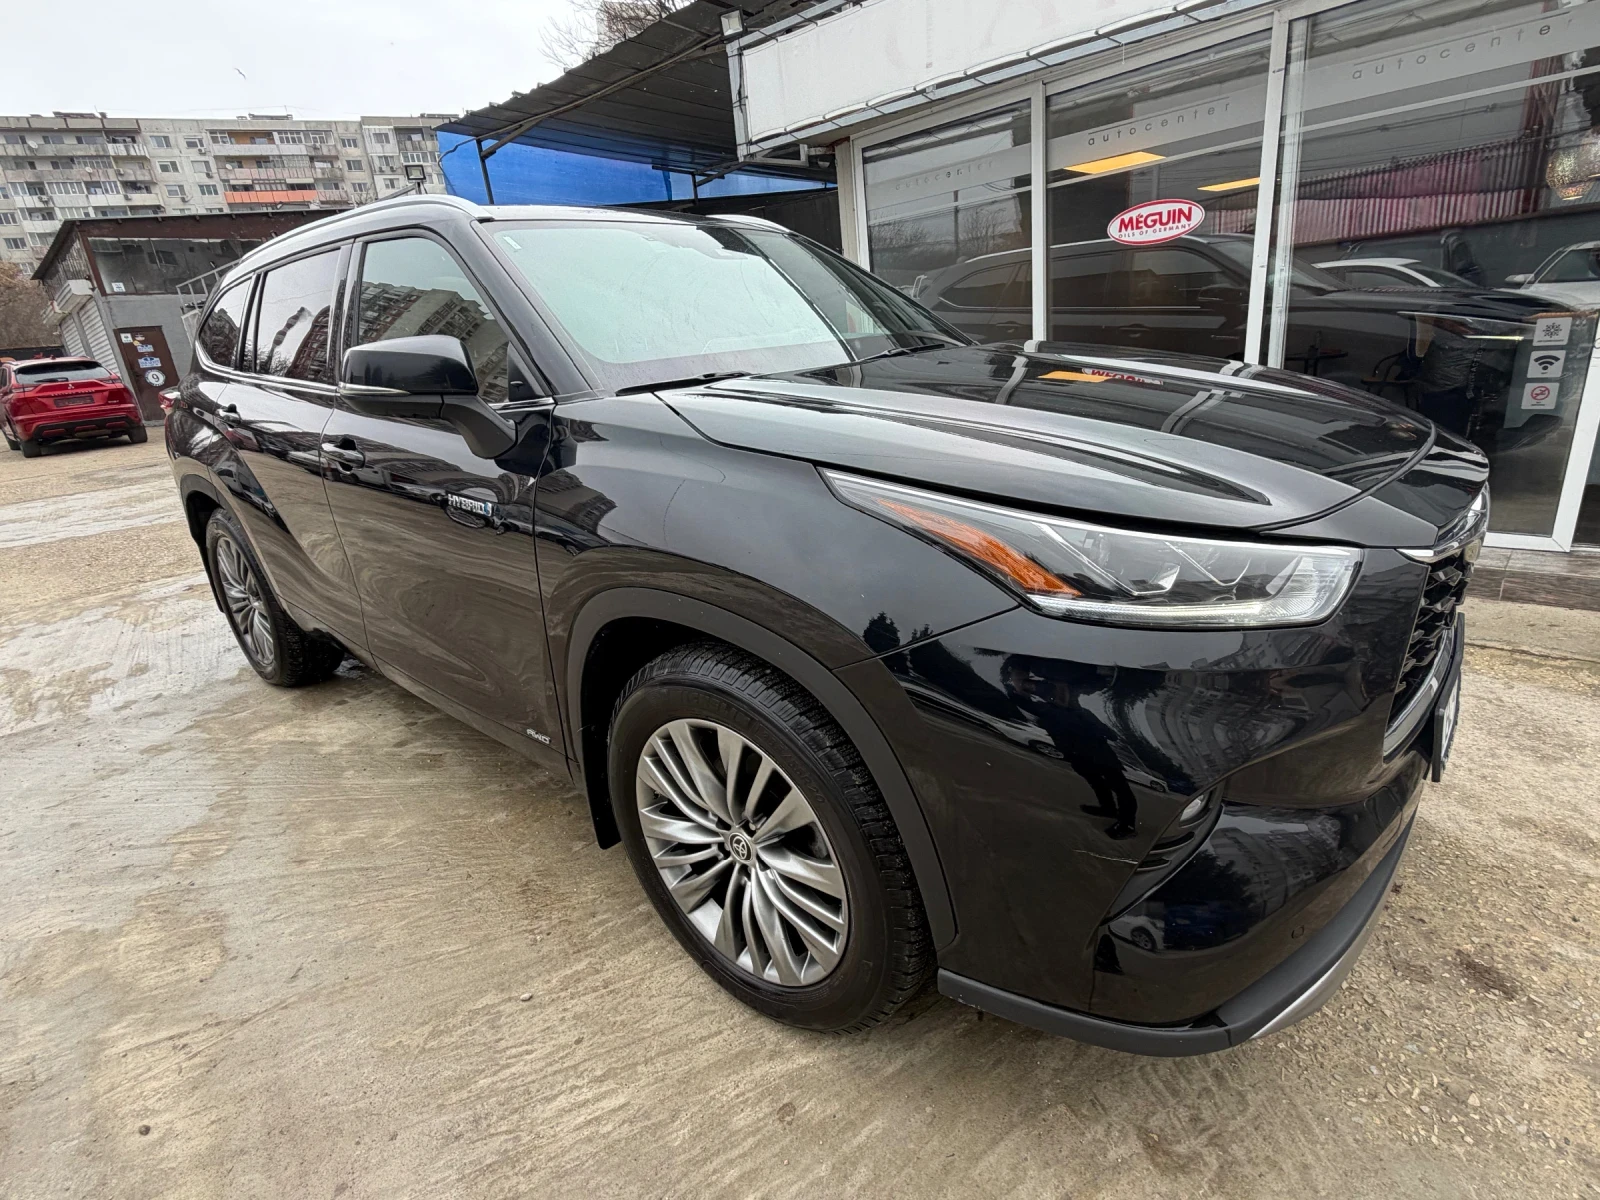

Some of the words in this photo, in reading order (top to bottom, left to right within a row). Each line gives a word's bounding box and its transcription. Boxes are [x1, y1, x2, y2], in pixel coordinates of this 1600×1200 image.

[1352, 18, 1573, 80] autocenter
[1088, 102, 1230, 146] autocenter
[1152, 223, 1191, 234] GERMANY
[151, 373, 161, 383] 9
[448, 495, 484, 515] HYBRID
